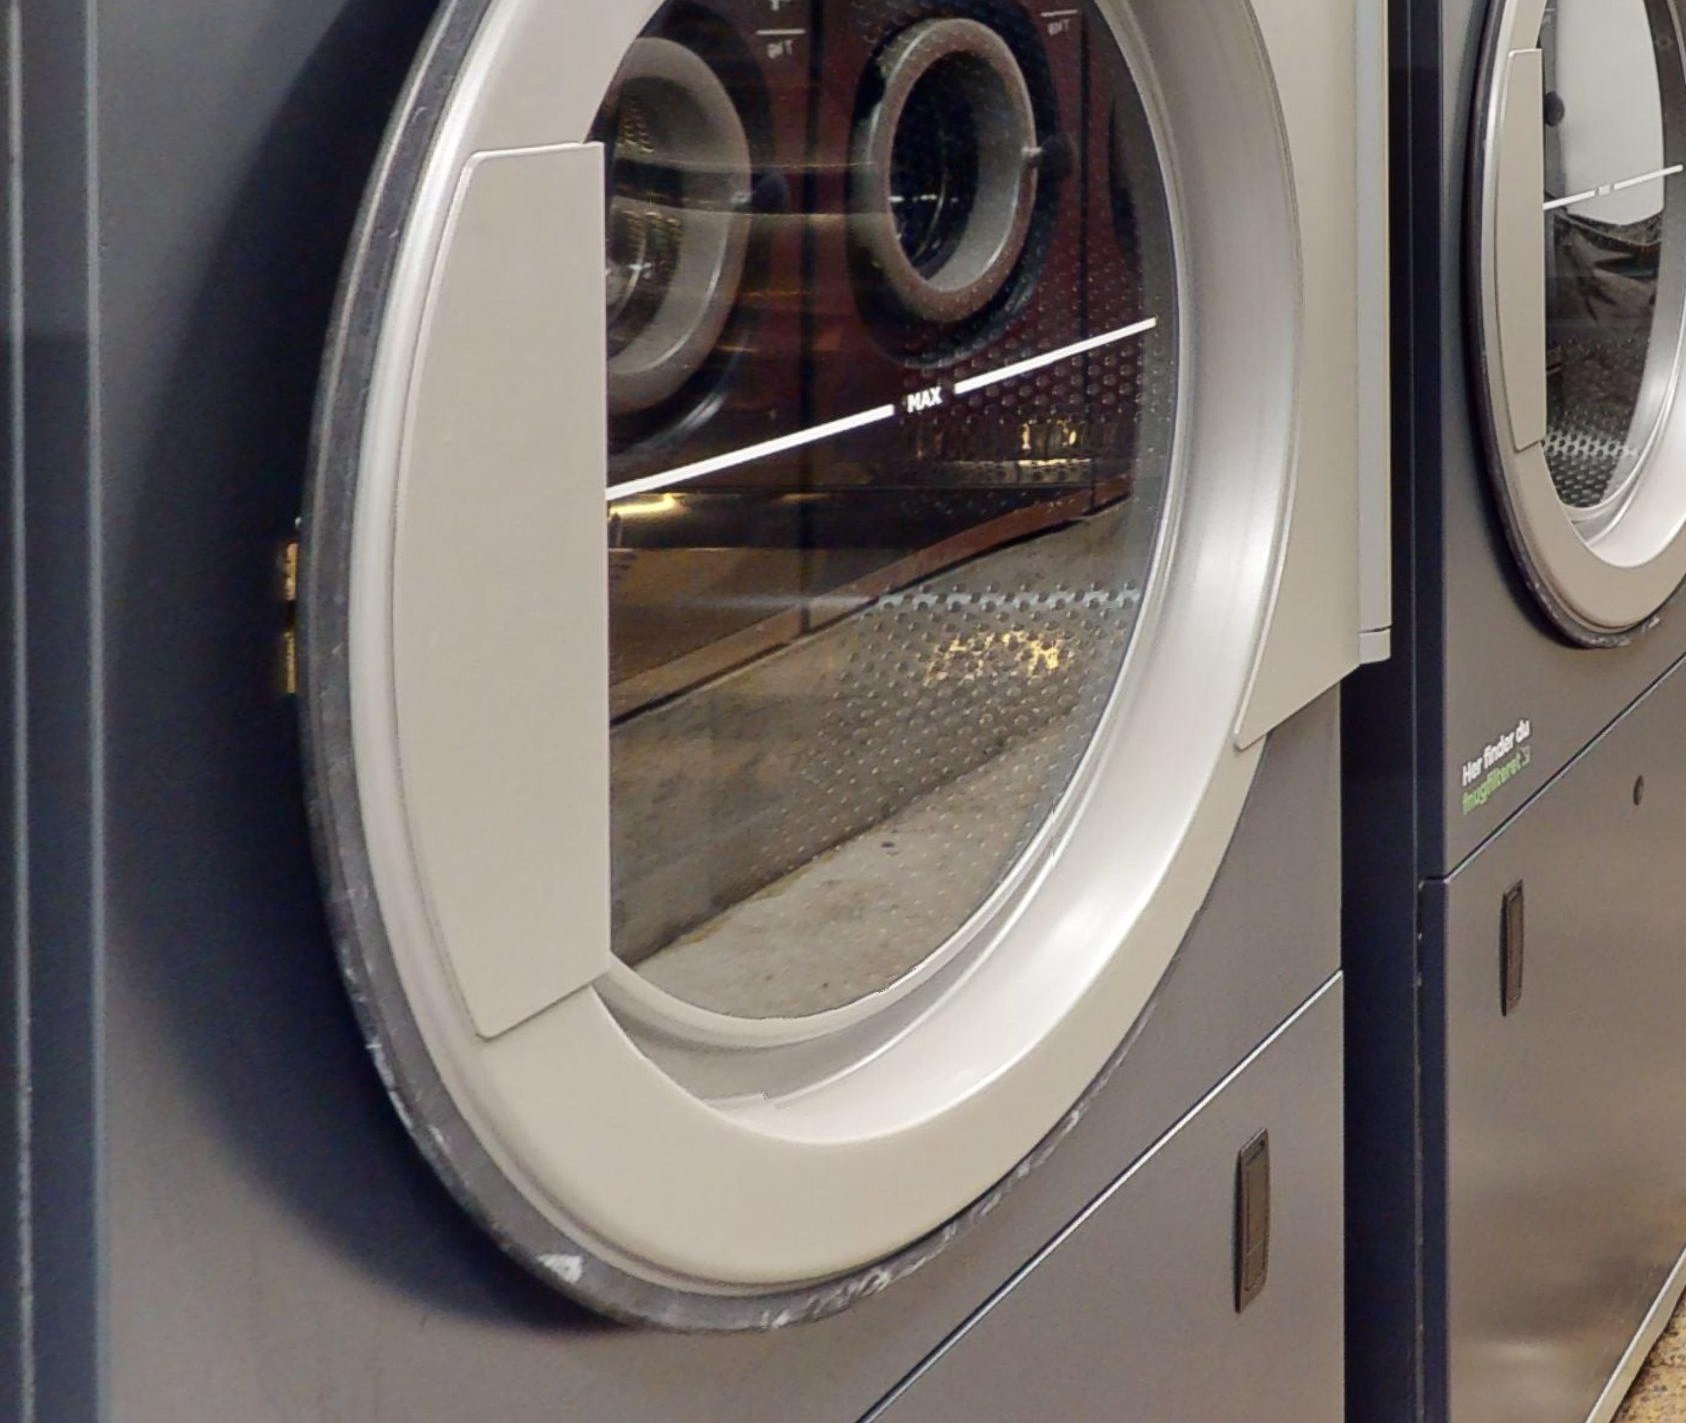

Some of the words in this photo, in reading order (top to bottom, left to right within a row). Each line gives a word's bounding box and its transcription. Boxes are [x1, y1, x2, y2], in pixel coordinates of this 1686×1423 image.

[906, 386, 944, 413] MAX
[1462, 757, 1483, 787] Her
[1483, 731, 1515, 770] finder
[1516, 720, 1530, 744] du
